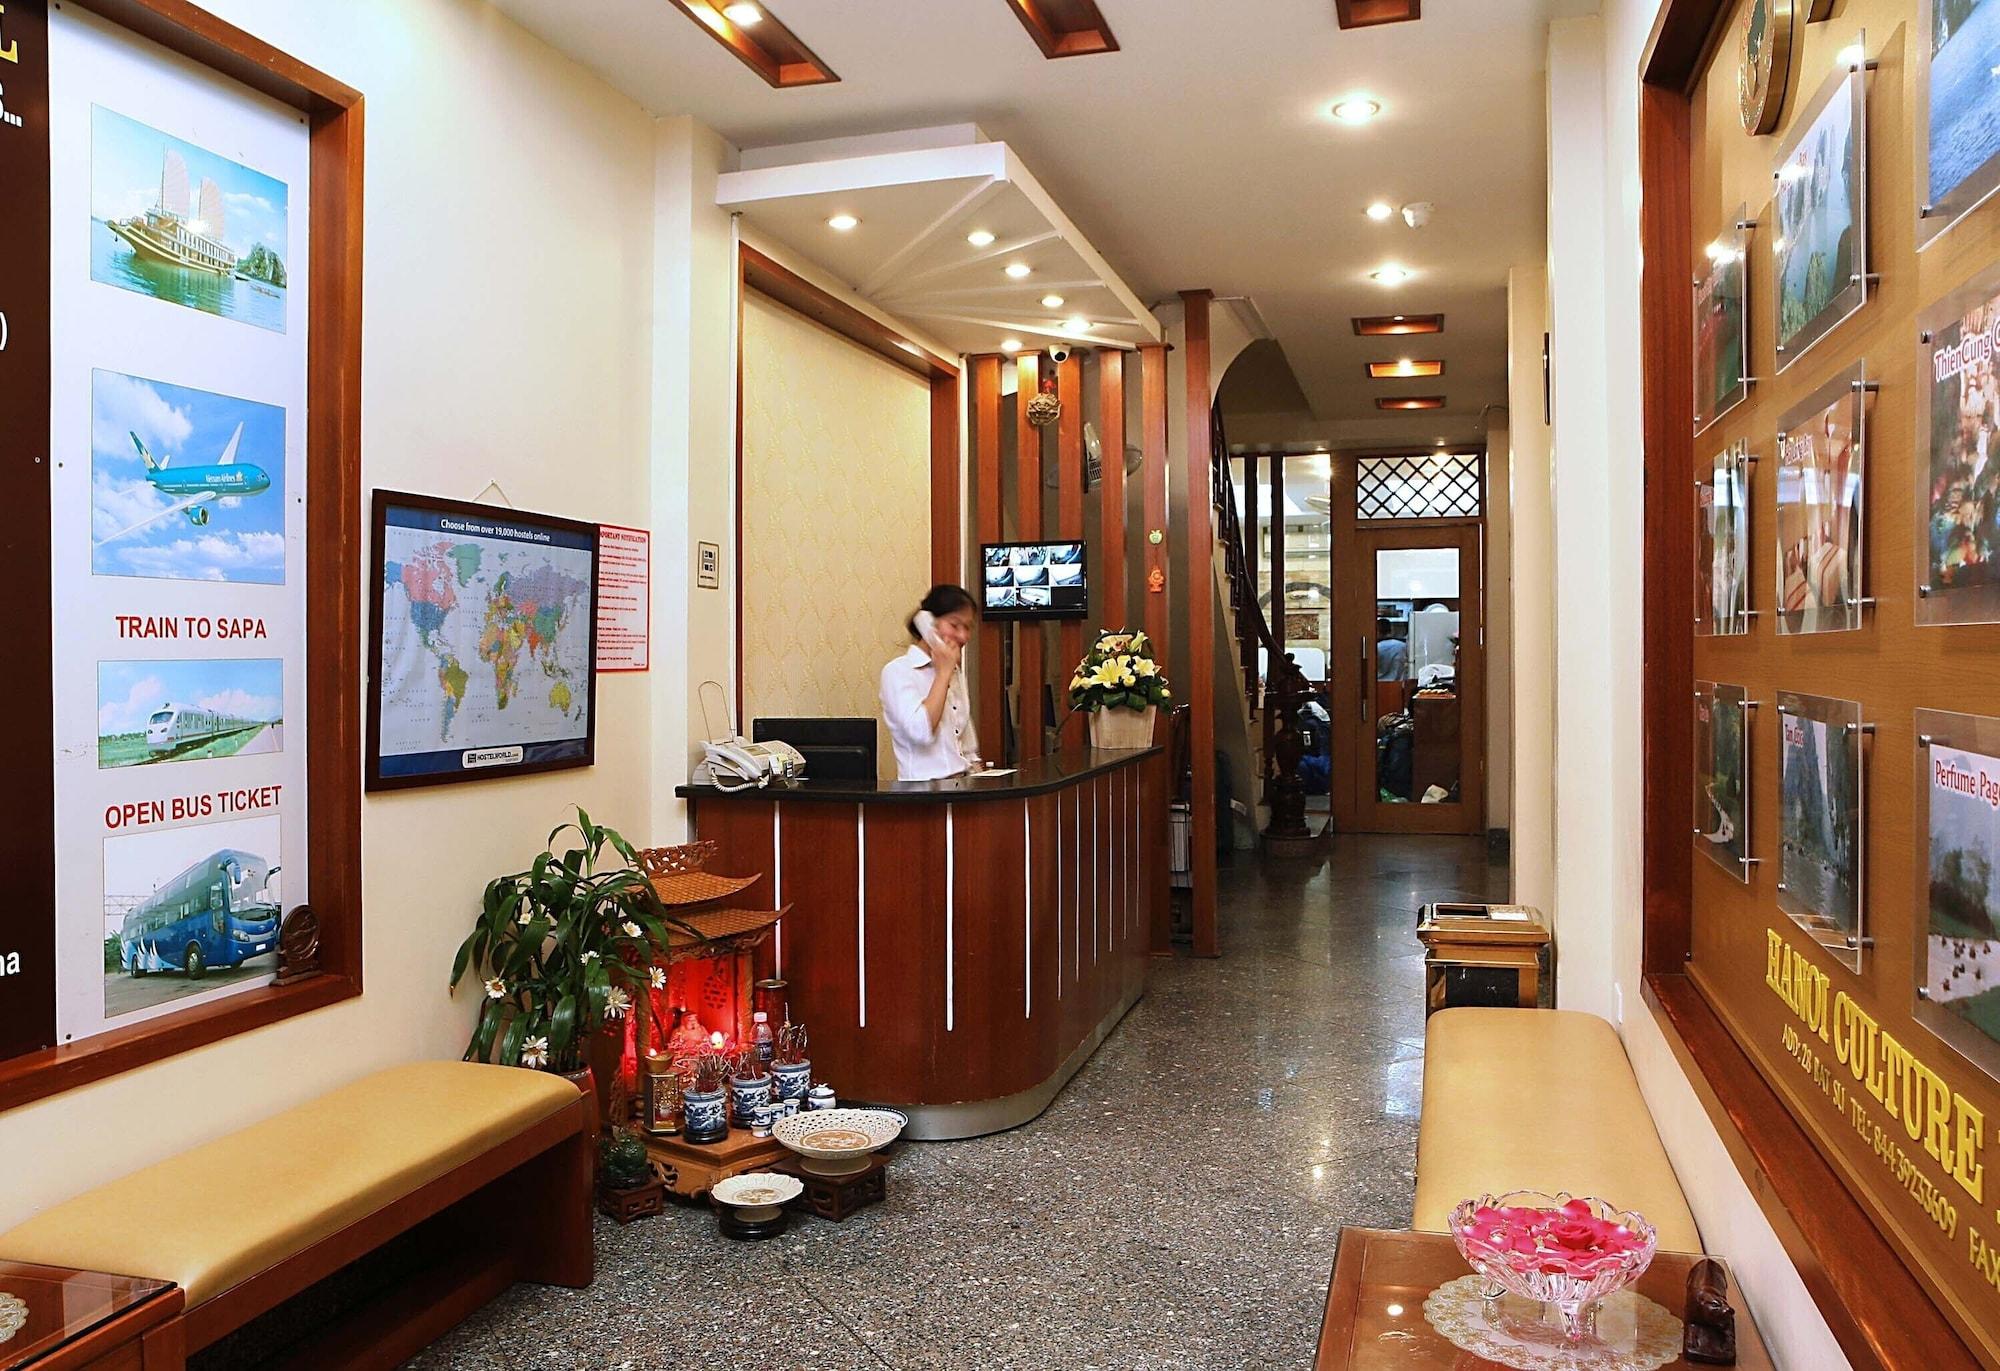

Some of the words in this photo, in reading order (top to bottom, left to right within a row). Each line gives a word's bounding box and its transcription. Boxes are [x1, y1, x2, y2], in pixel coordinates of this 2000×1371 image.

[440, 519, 465, 531] Choose
[465, 522, 480, 533] from
[480, 525, 495, 534] over
[495, 526, 513, 537] 19,000
[513, 529, 533, 540] hostels
[533, 532, 550, 542] online
[115, 616, 178, 639] TRAIN
[184, 617, 211, 639] TO
[217, 618, 267, 639] SAPA
[1935, 759, 1976, 795] Perfume
[1980, 770, 2000, 807] Pag
[105, 800, 164, 829] OPEN
[172, 794, 212, 820] BUS
[217, 785, 282, 813] TICKET
[1766, 928, 1830, 1044] HANOI
[1833, 991, 1984, 1205] CULTURE
[1782, 1023, 1801, 1063] ADD:
[1801, 1043, 1812, 1074] 28
[1850, 1096, 1871, 1145] TEL:
